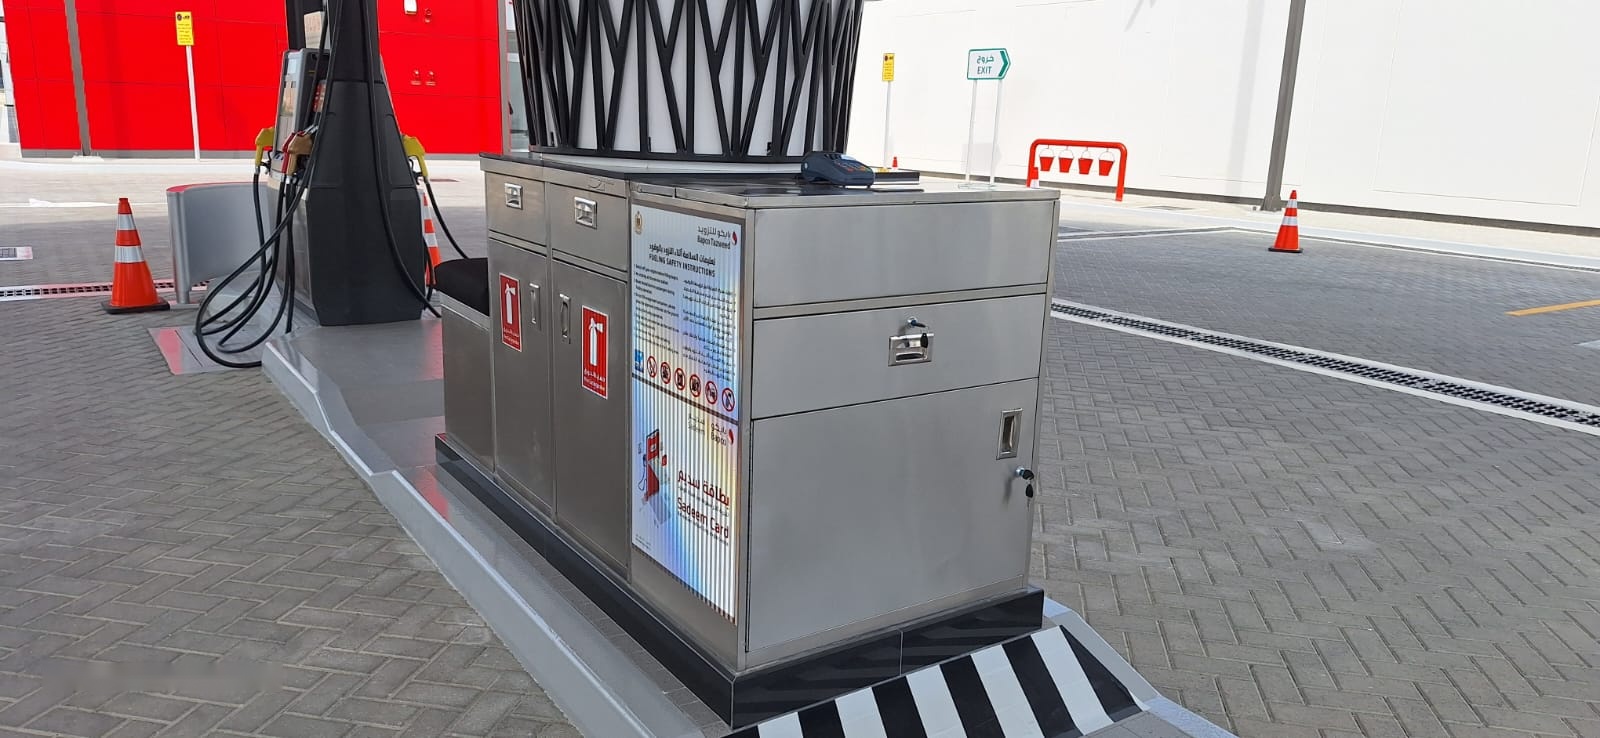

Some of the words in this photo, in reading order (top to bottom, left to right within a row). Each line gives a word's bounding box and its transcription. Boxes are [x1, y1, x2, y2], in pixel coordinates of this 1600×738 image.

[976, 55, 994, 64] خروج
[977, 66, 992, 75] EXIT
[683, 249, 699, 261] السلامة
[648, 253, 666, 264] FUELING
[666, 257, 682, 269] SAFETY
[682, 261, 716, 278] INSTRUCTIONS
[677, 470, 700, 490] سديم
[702, 480, 730, 510] بطاقة
[677, 497, 708, 527] Sadeem
[710, 516, 729, 539] Card
